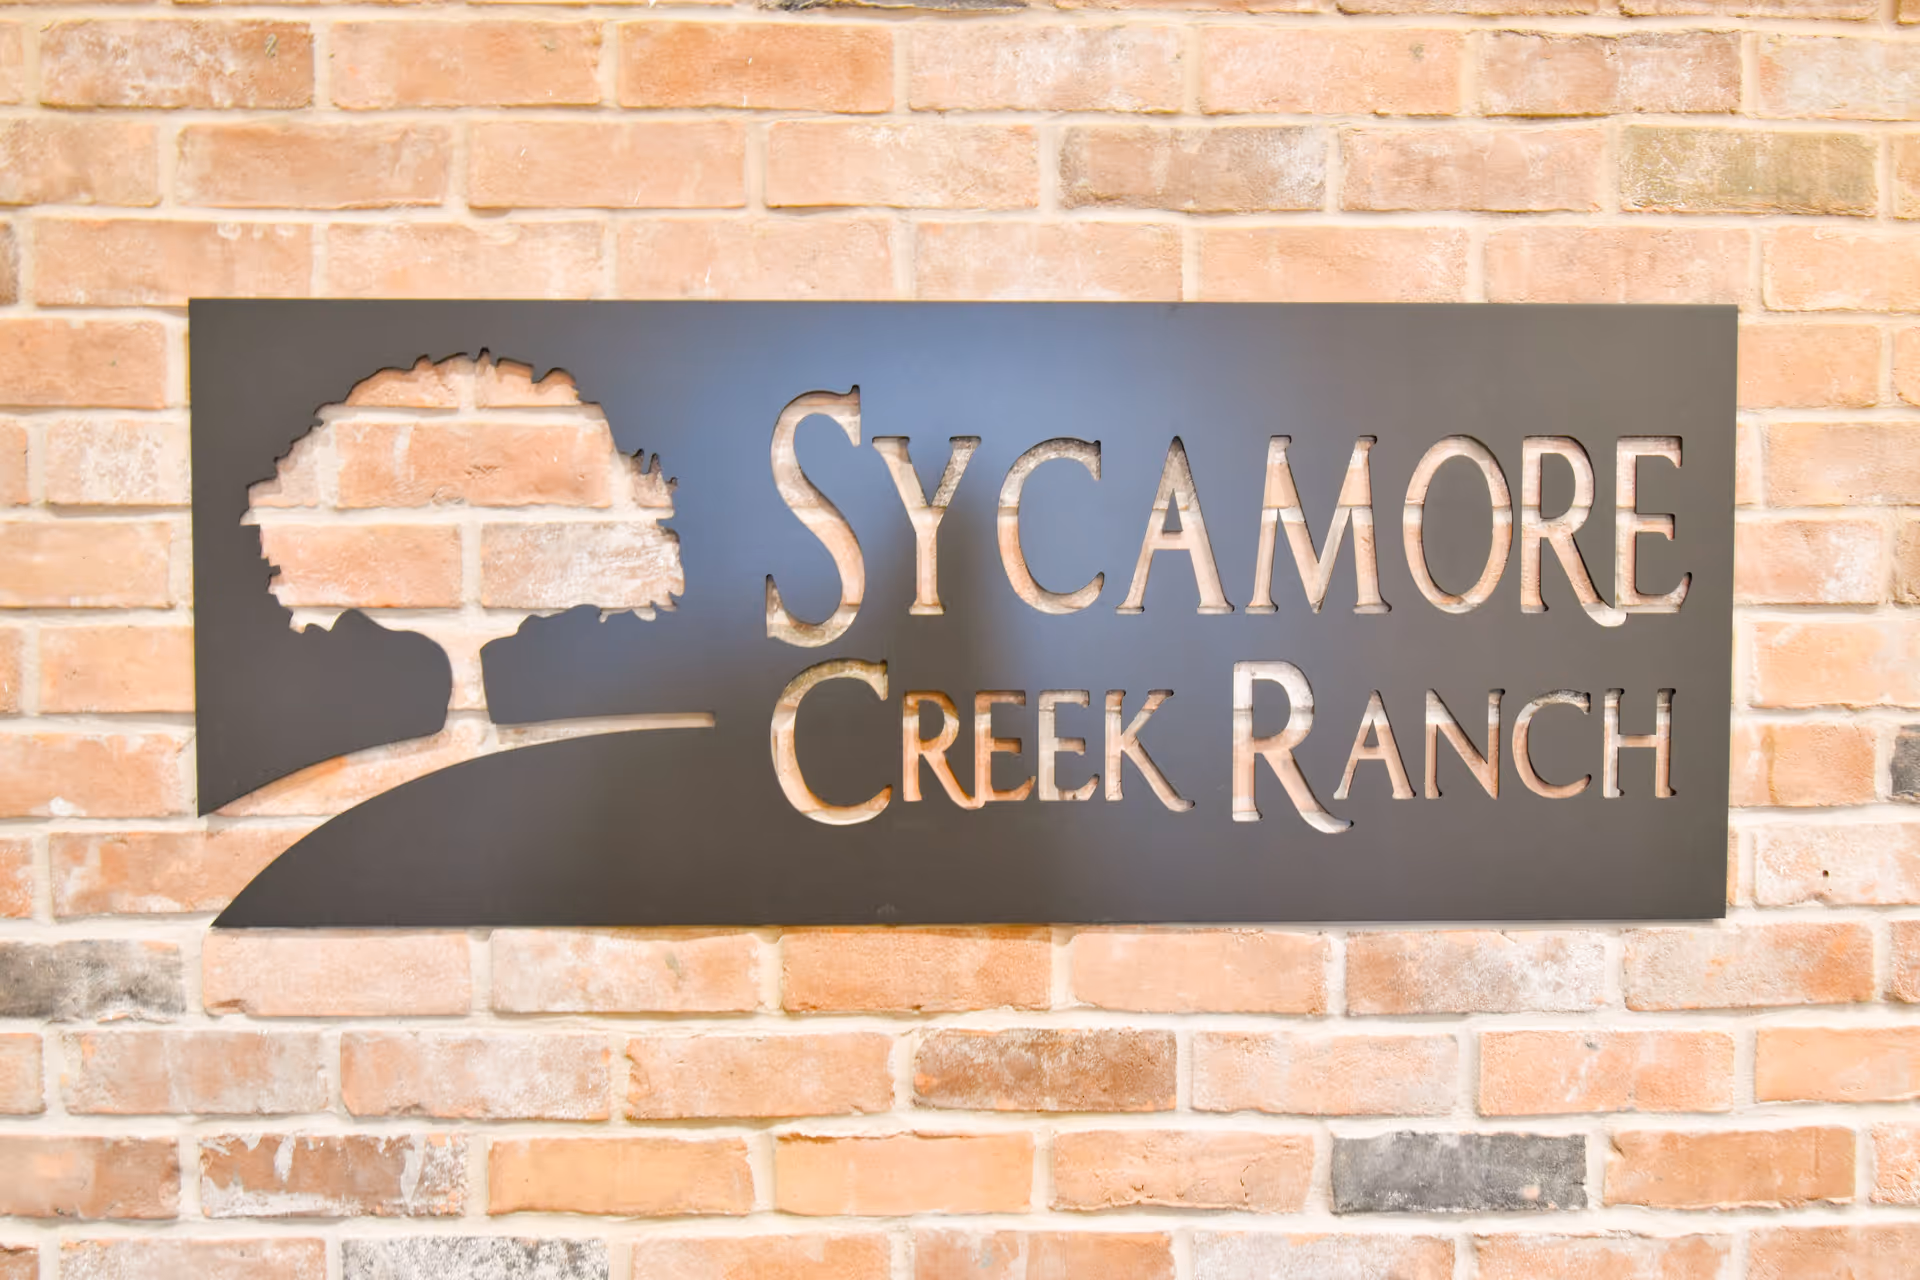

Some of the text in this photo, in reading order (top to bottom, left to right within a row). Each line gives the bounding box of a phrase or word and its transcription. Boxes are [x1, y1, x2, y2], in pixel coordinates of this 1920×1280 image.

[766, 384, 1692, 648] SYCAMORE
[770, 657, 1677, 834] CREEK RANCH
